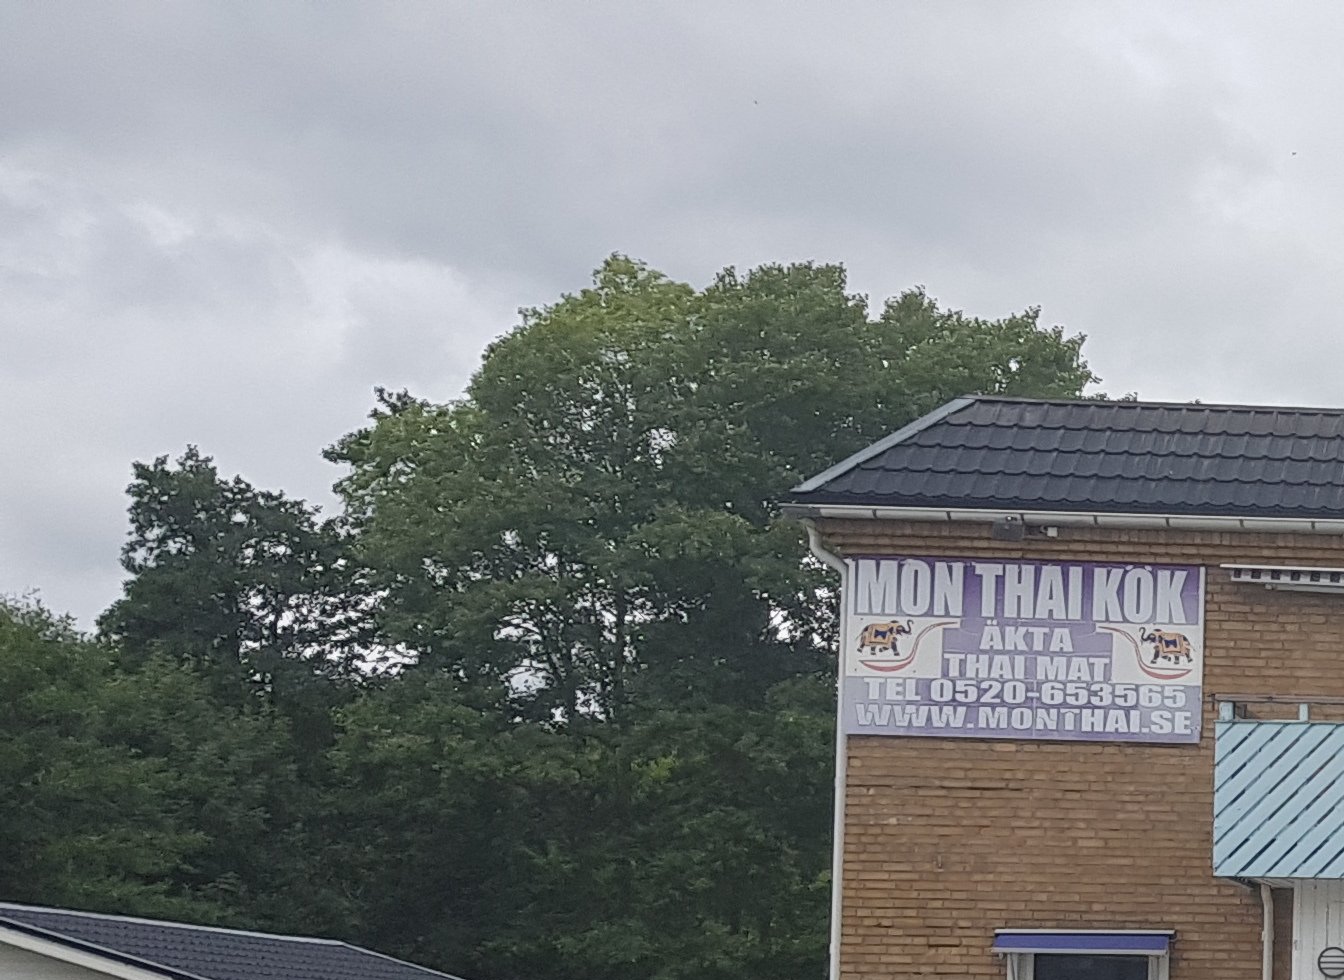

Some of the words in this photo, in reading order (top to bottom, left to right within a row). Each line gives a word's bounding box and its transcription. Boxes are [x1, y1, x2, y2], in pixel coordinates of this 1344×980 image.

[857, 559, 964, 616] MON
[972, 562, 1083, 620] THAI
[1093, 565, 1188, 623] KÖK
[979, 620, 1073, 652] ÄKTA
[944, 653, 1025, 679] THAI
[1035, 656, 1110, 681] MAT
[864, 677, 920, 701] TEL
[930, 680, 1185, 708] 0520-653565
[856, 704, 1192, 734] WWW.MONTHAI.SE
